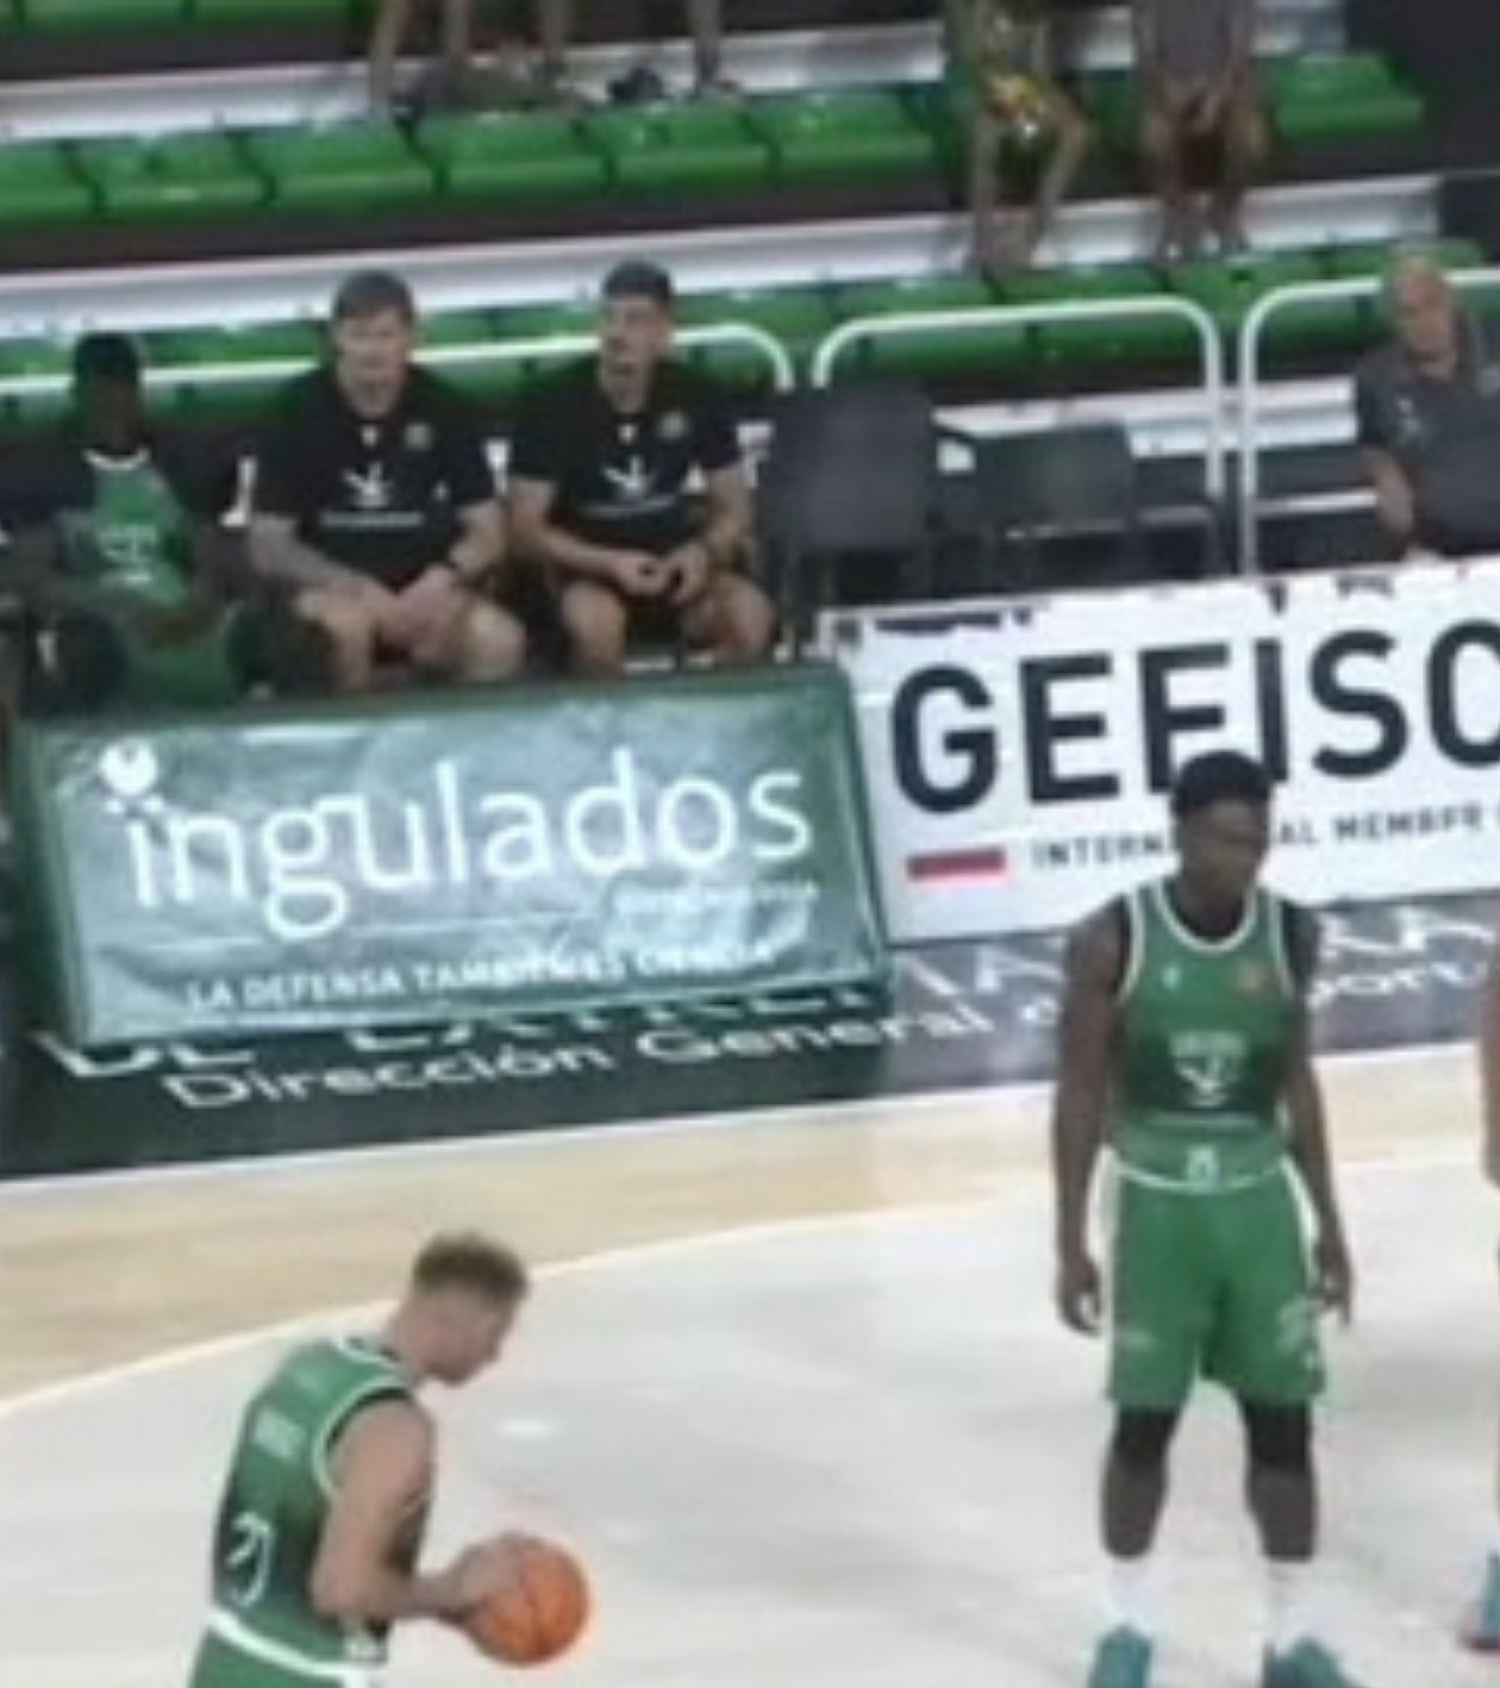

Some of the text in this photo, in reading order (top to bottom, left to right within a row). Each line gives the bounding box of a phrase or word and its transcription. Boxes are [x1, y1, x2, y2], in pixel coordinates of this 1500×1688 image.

[244, 968, 403, 1008] DEFENSA
[160, 1042, 615, 1108] Dirección
[636, 996, 994, 1063] General
